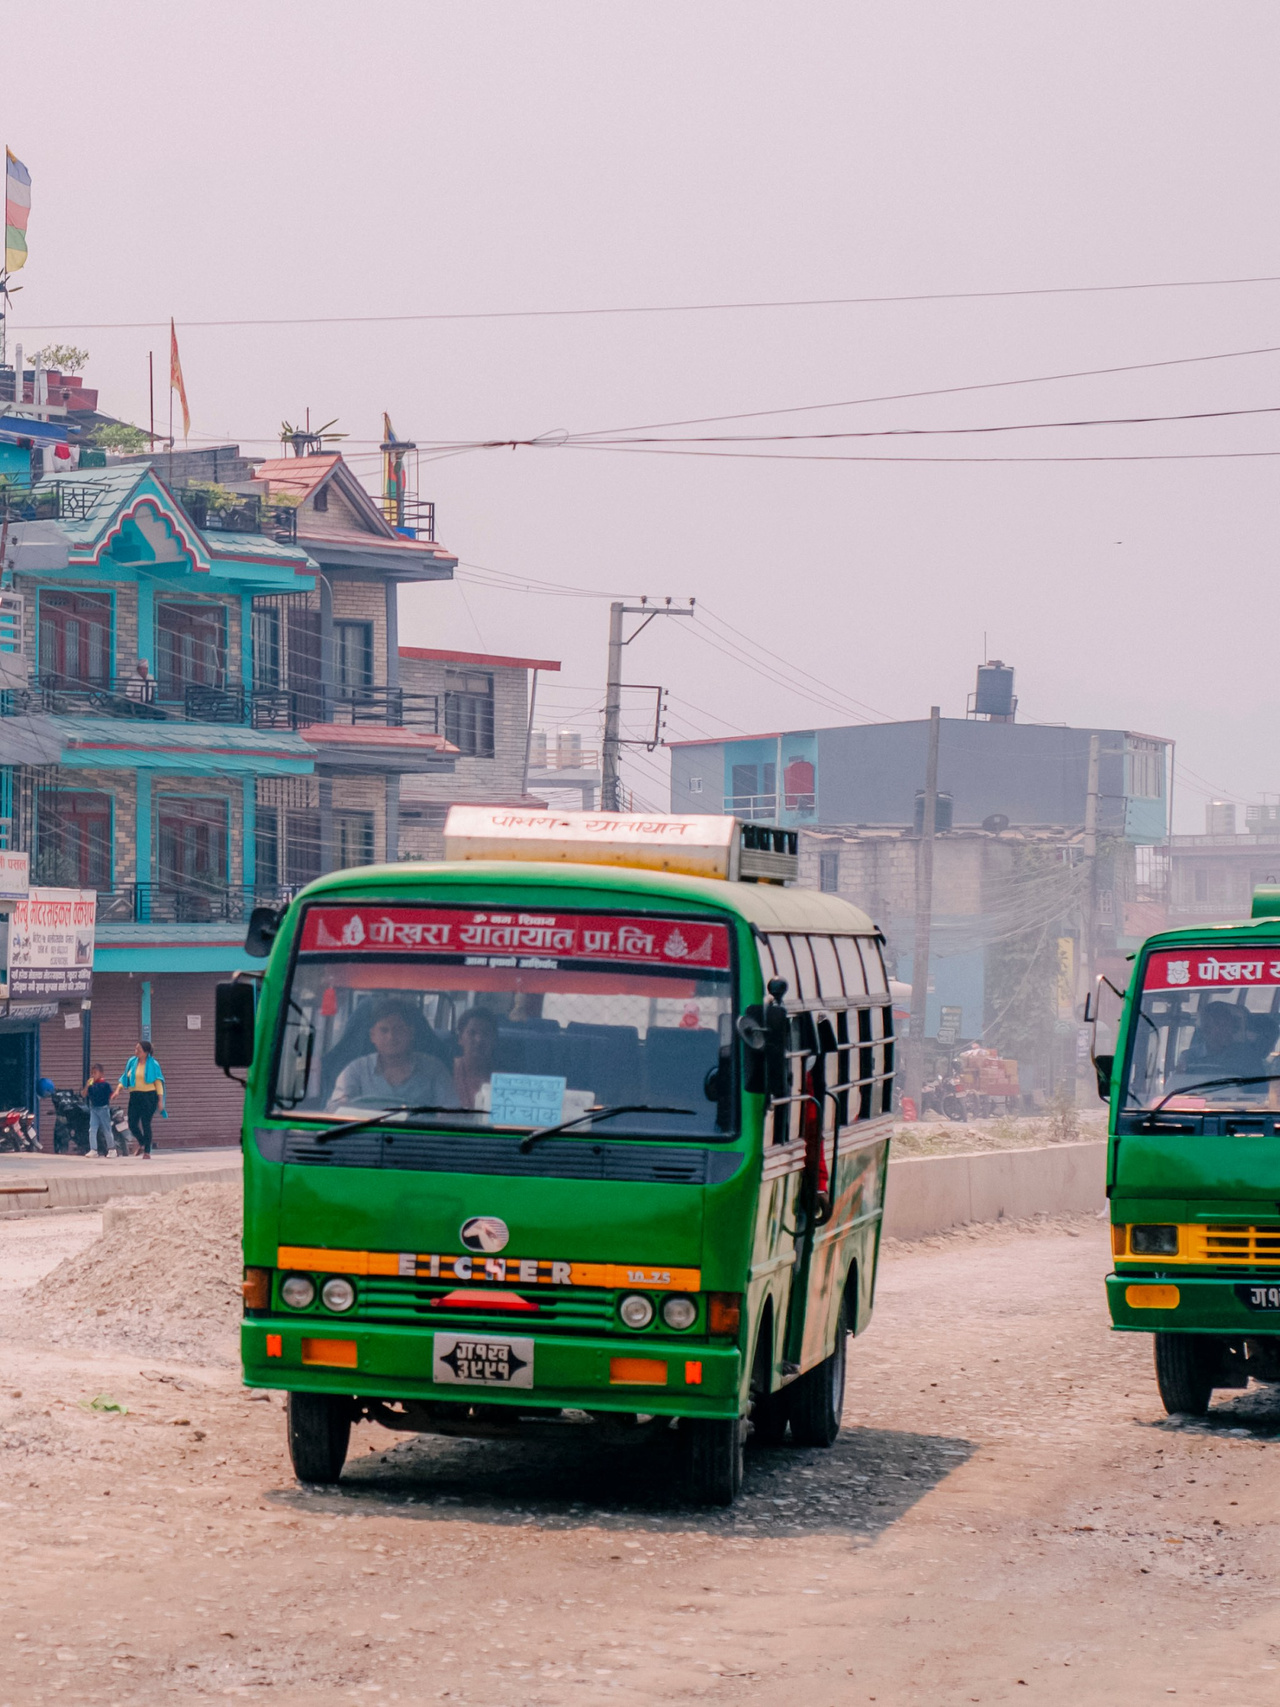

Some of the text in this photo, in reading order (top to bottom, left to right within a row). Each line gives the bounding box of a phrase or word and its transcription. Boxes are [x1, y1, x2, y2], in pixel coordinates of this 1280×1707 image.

[7, 858, 27, 870] पसल
[368, 917, 450, 947] पोखरा
[460, 925, 573, 950] यातायात
[1198, 957, 1265, 981] पोखरा
[398, 1253, 573, 1285] EICHER
